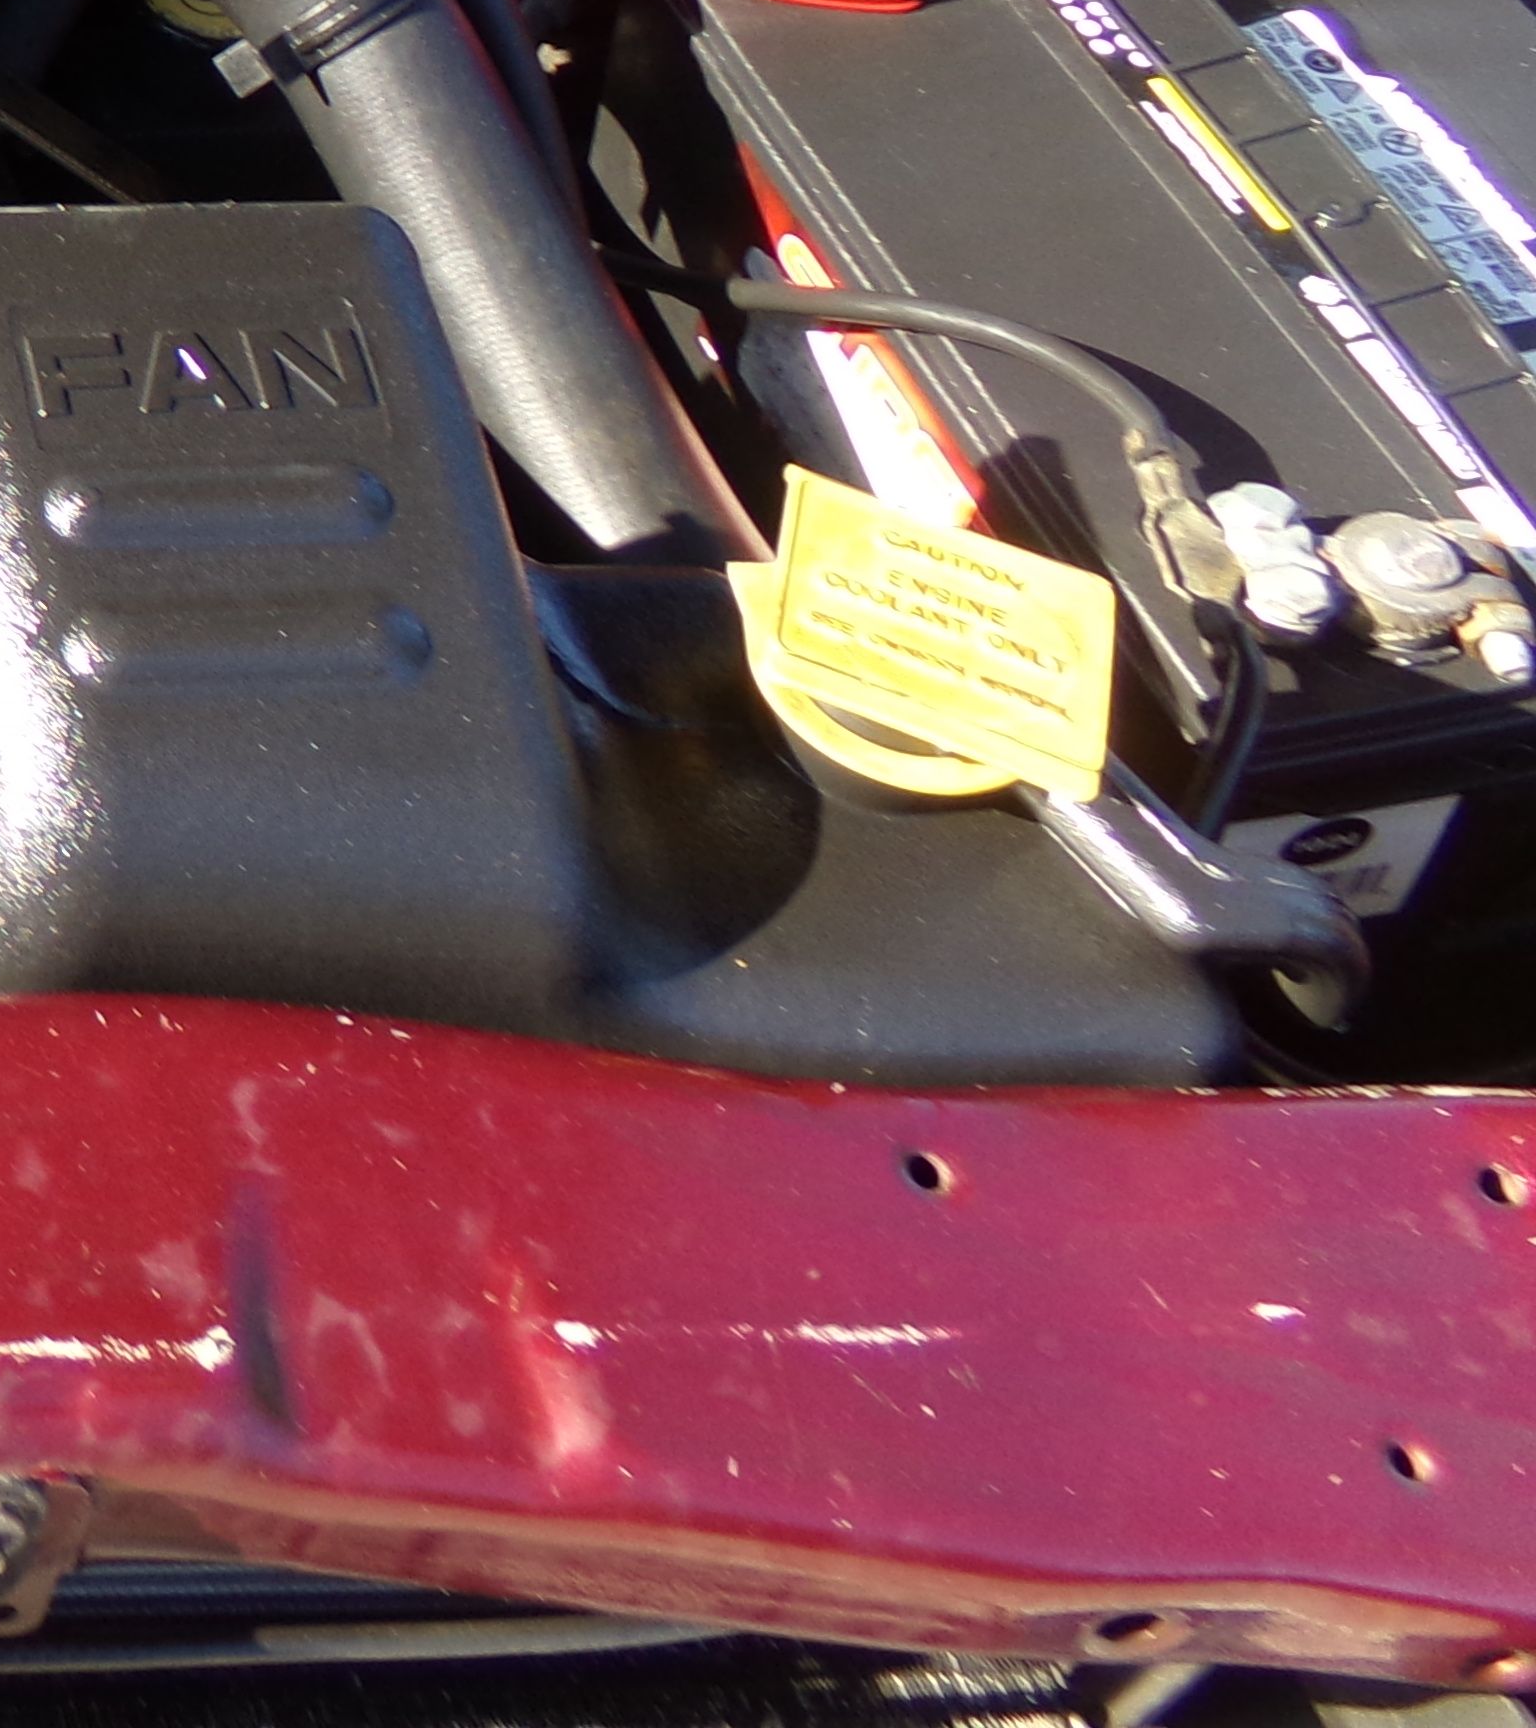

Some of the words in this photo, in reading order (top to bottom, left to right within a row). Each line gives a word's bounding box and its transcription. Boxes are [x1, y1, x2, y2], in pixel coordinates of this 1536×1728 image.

[24, 328, 381, 418] FAN
[882, 530, 1024, 591] CAUTION
[987, 634, 1066, 674] ONLY
